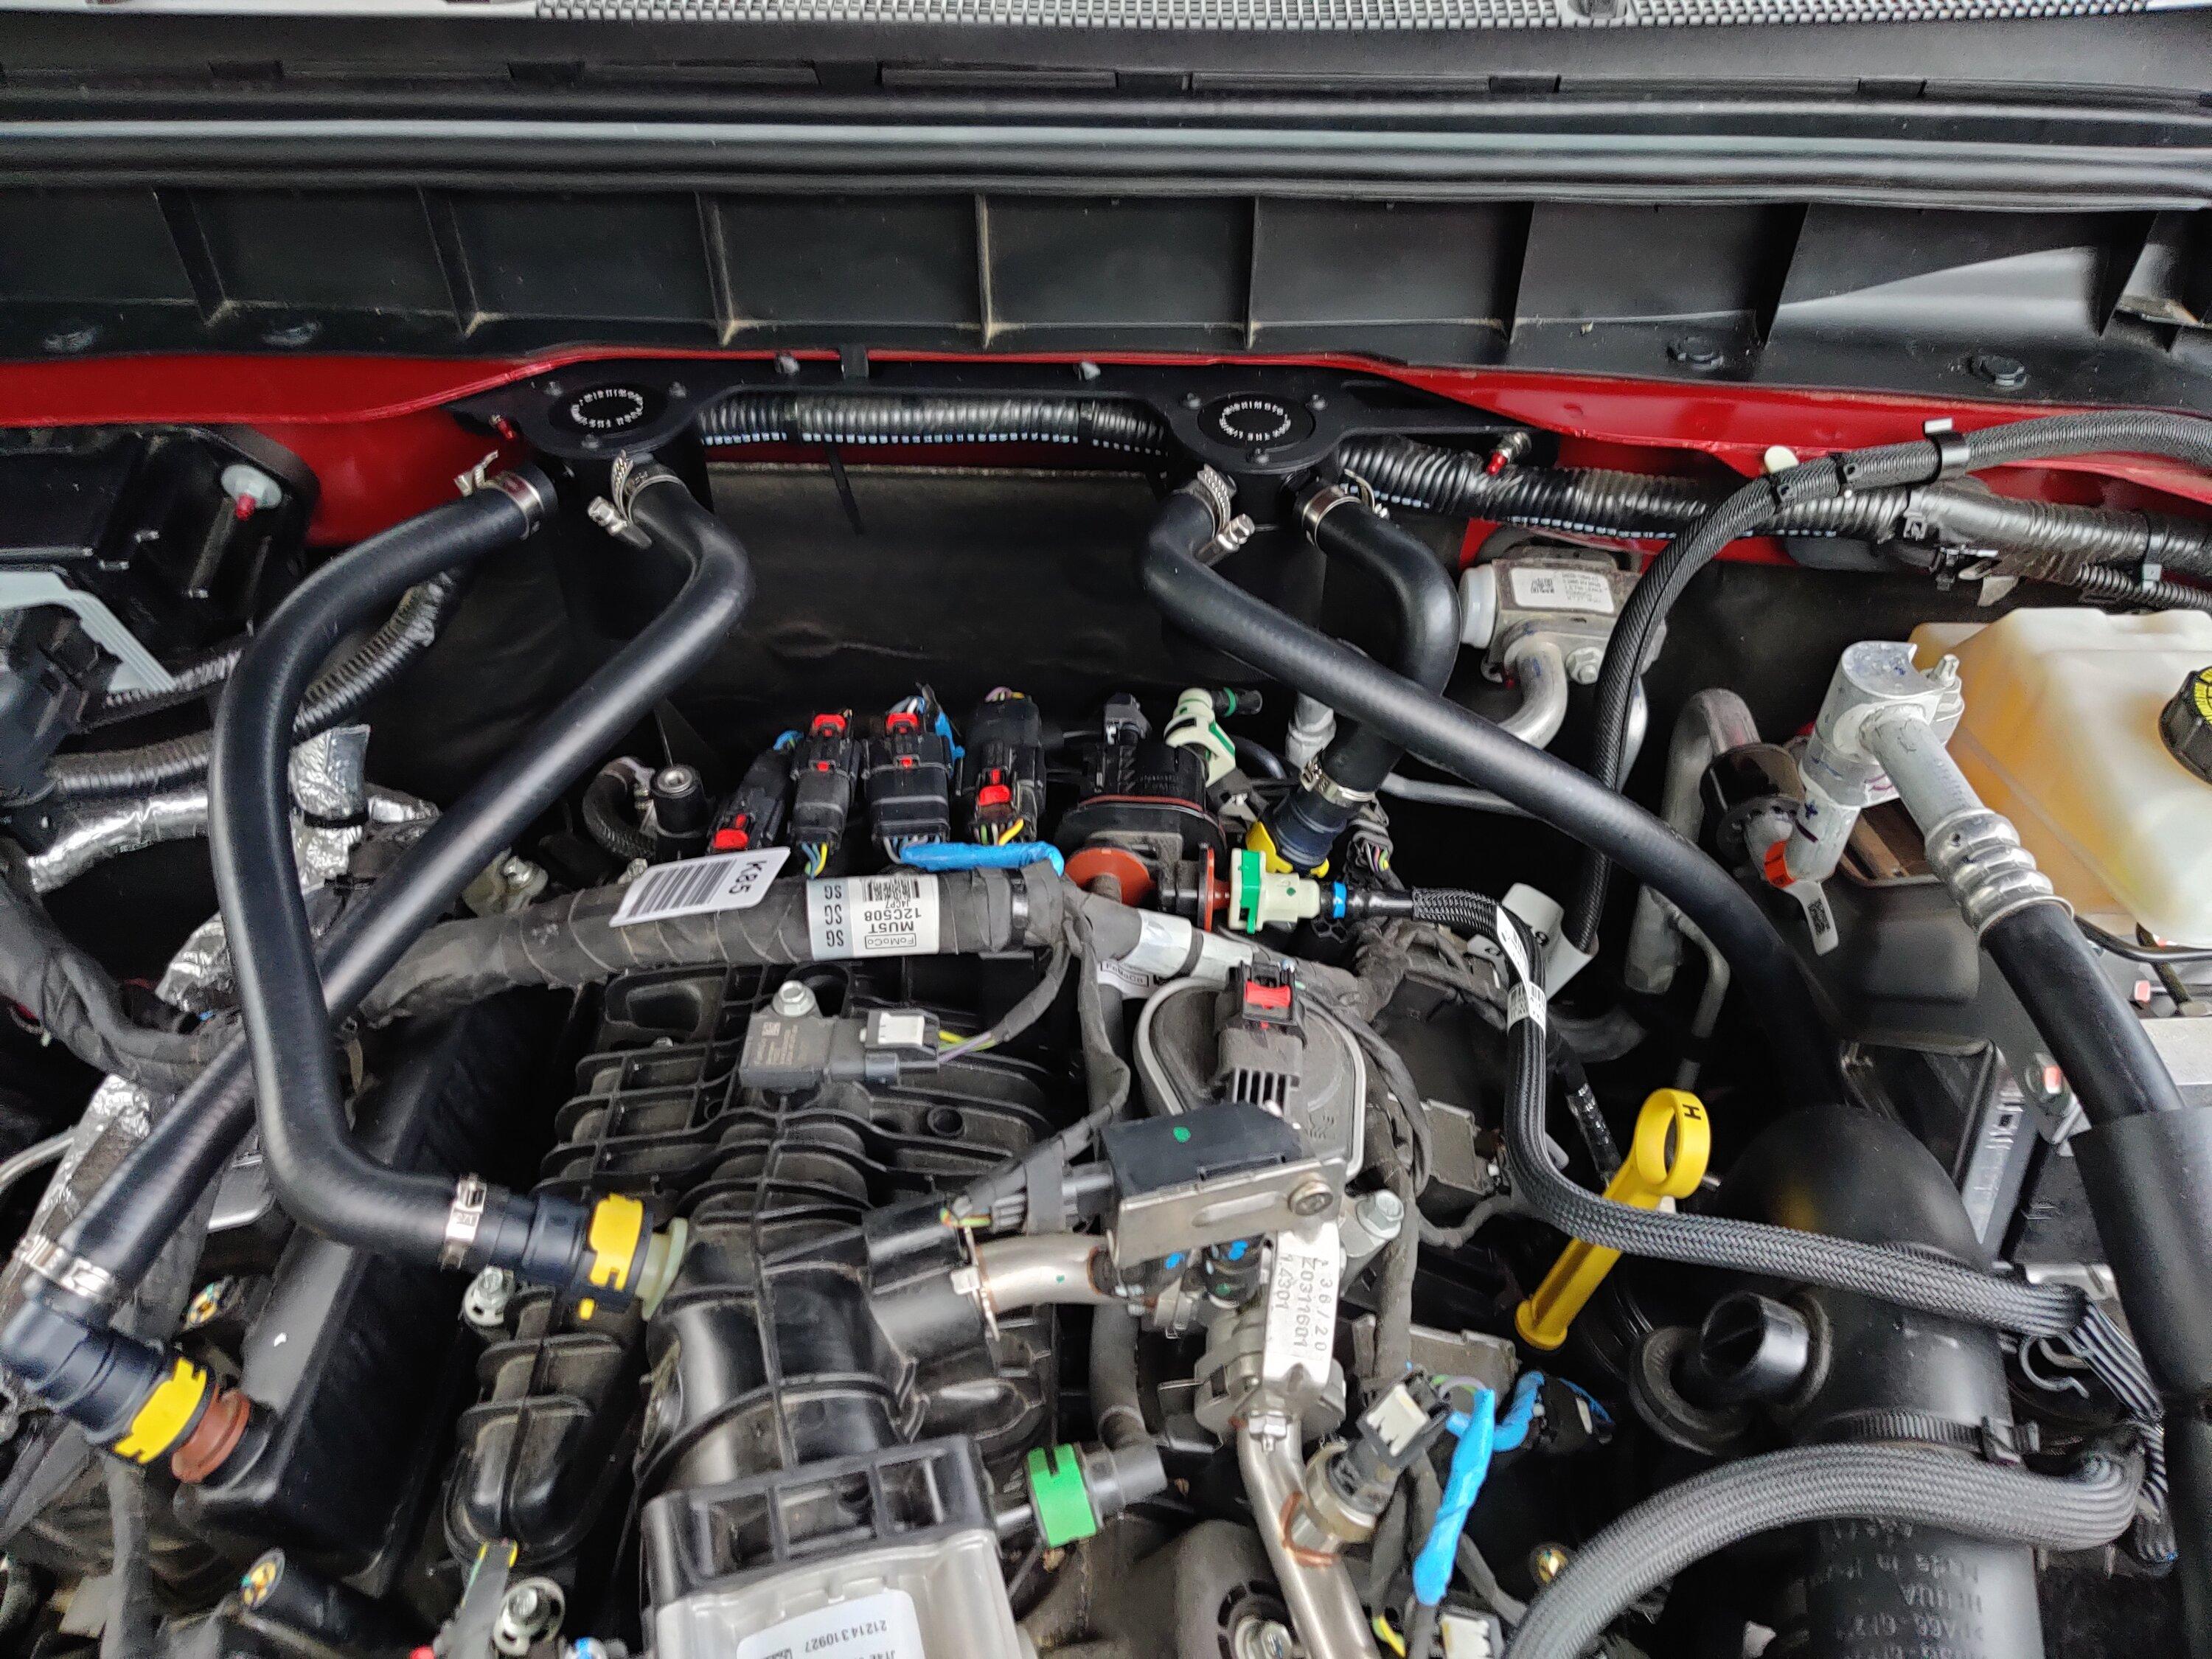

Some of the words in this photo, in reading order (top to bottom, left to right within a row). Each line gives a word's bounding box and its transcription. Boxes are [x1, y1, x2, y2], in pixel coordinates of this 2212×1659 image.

[824, 885, 841, 900] SG
[824, 905, 842, 925] SG
[864, 908, 922, 921] 12C508
[868, 921, 914, 933] MU5T
[826, 930, 844, 947] SG
[867, 936, 914, 947] FoMoCo
[1683, 1104, 1701, 1120] H
[1276, 1253, 1293, 1310] 1.4301
[1294, 1256, 1318, 1347] Z0311601
